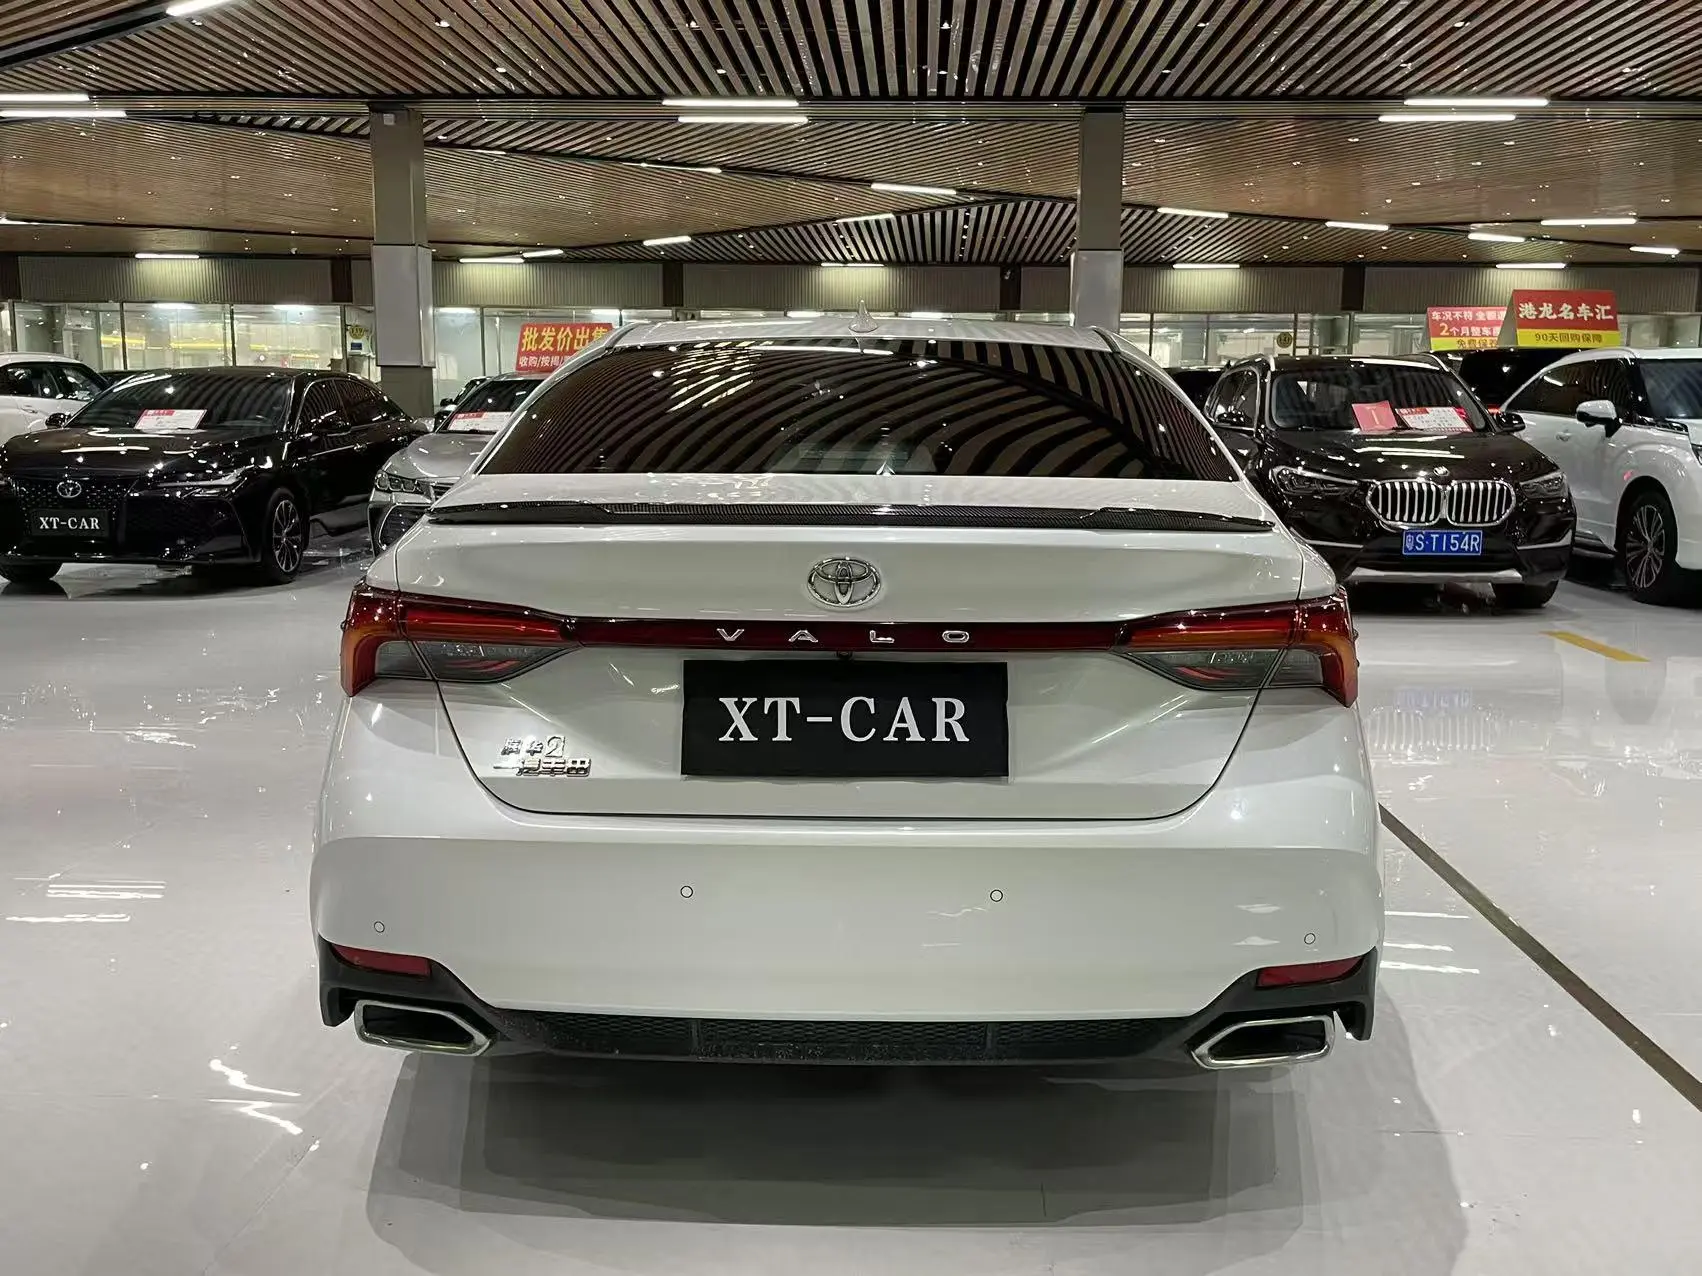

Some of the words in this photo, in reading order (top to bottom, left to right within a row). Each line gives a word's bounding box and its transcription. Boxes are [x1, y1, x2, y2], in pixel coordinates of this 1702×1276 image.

[1518, 302, 1614, 320] 港龙名车汇
[519, 355, 571, 367] 收购/按揭/
[39, 516, 100, 530] XT-CAR
[718, 696, 970, 742] XT-CAR
